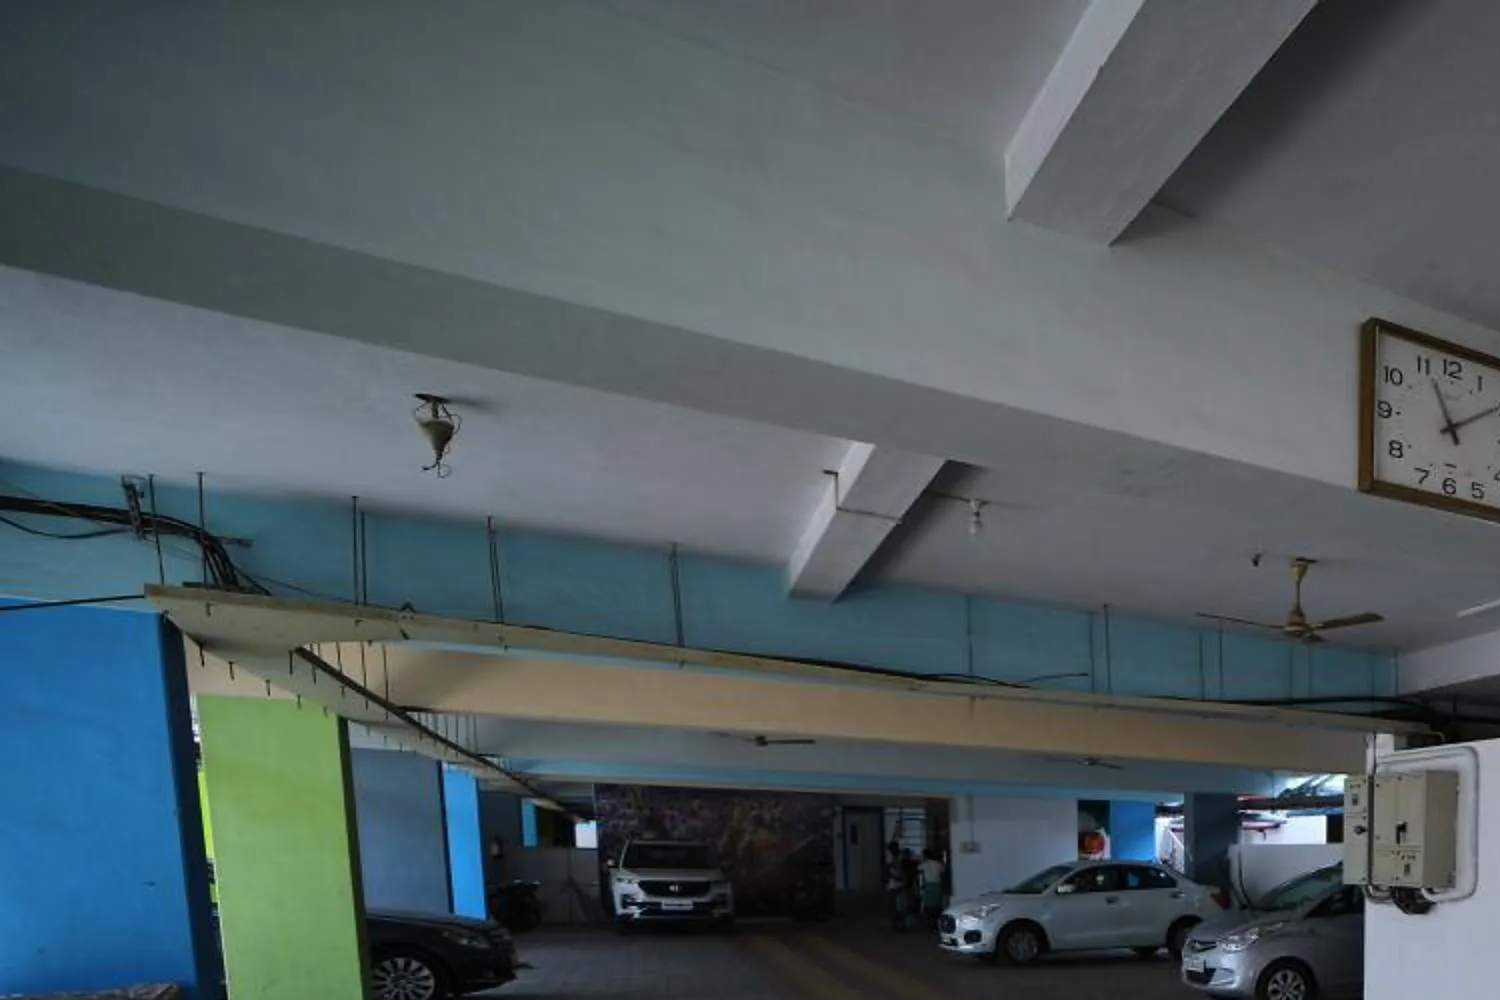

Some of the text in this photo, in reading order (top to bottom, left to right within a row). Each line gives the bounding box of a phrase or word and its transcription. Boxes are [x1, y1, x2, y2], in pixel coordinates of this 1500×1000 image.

[1417, 355, 1430, 376] 11
[1442, 359, 1463, 380] 12
[1384, 365, 1403, 386] 10
[1477, 375, 1483, 392] 1
[1377, 401, 1392, 419] 9
[1388, 440, 1404, 458] 8
[1414, 467, 1430, 484] 7
[1442, 477, 1457, 495] 6
[1471, 482, 1484, 499] 5
